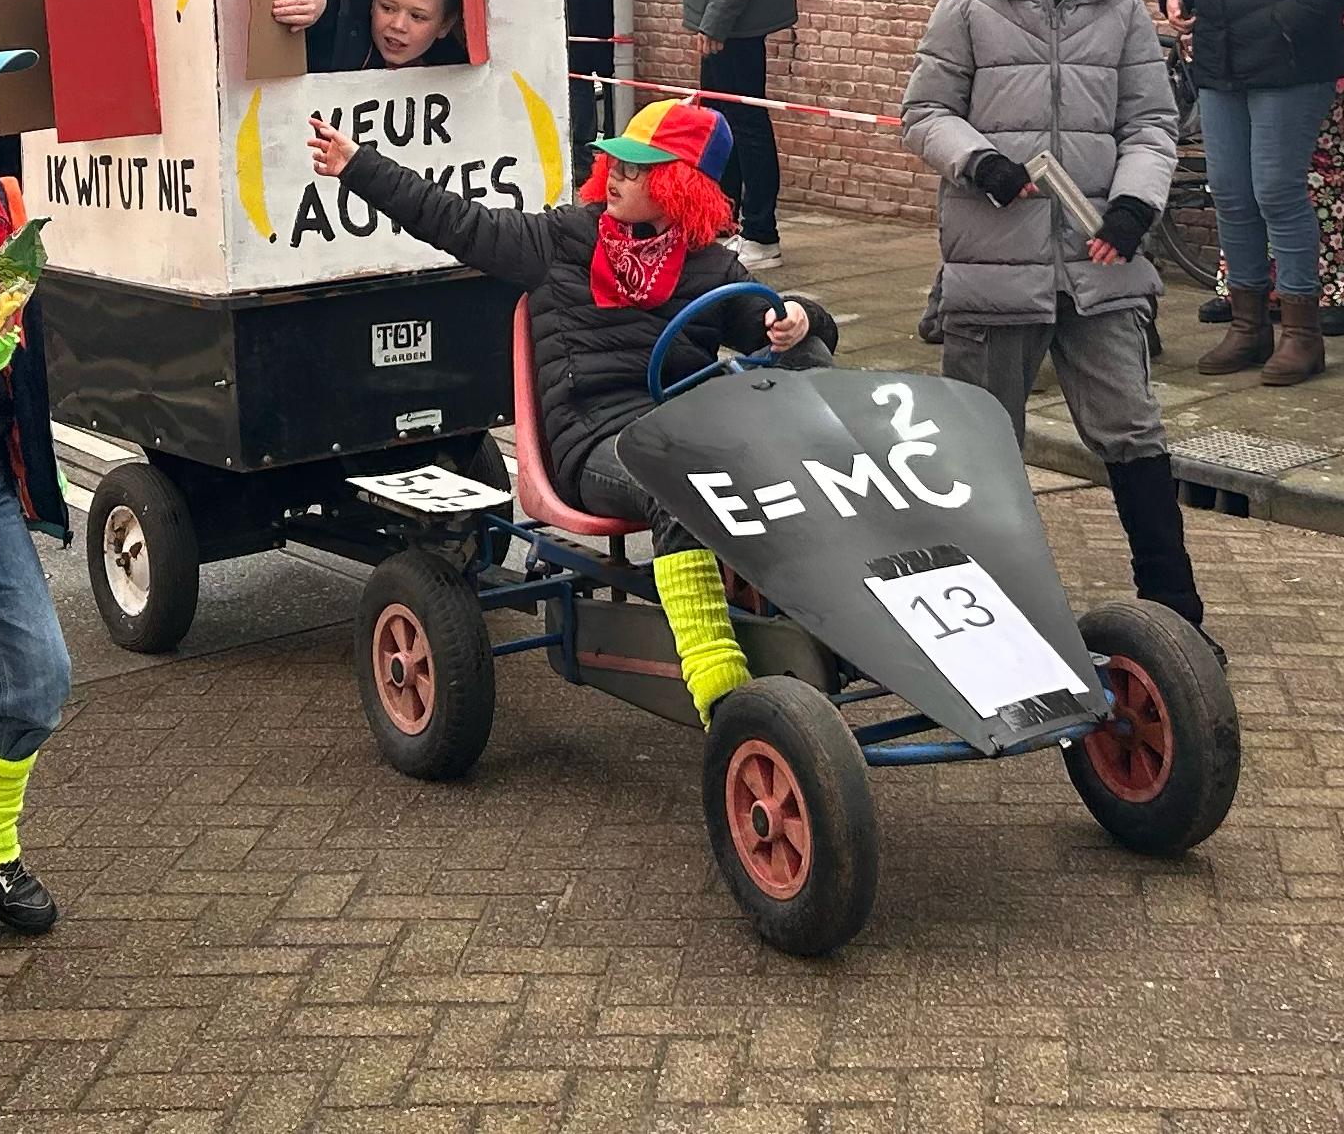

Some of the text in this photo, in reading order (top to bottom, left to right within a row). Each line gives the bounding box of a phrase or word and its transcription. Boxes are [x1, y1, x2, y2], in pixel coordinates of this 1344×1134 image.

[46, 153, 198, 218] IK WIT UT NIE
[376, 321, 428, 351] TOP
[383, 351, 427, 364] GARDEN
[909, 586, 996, 641] 13
